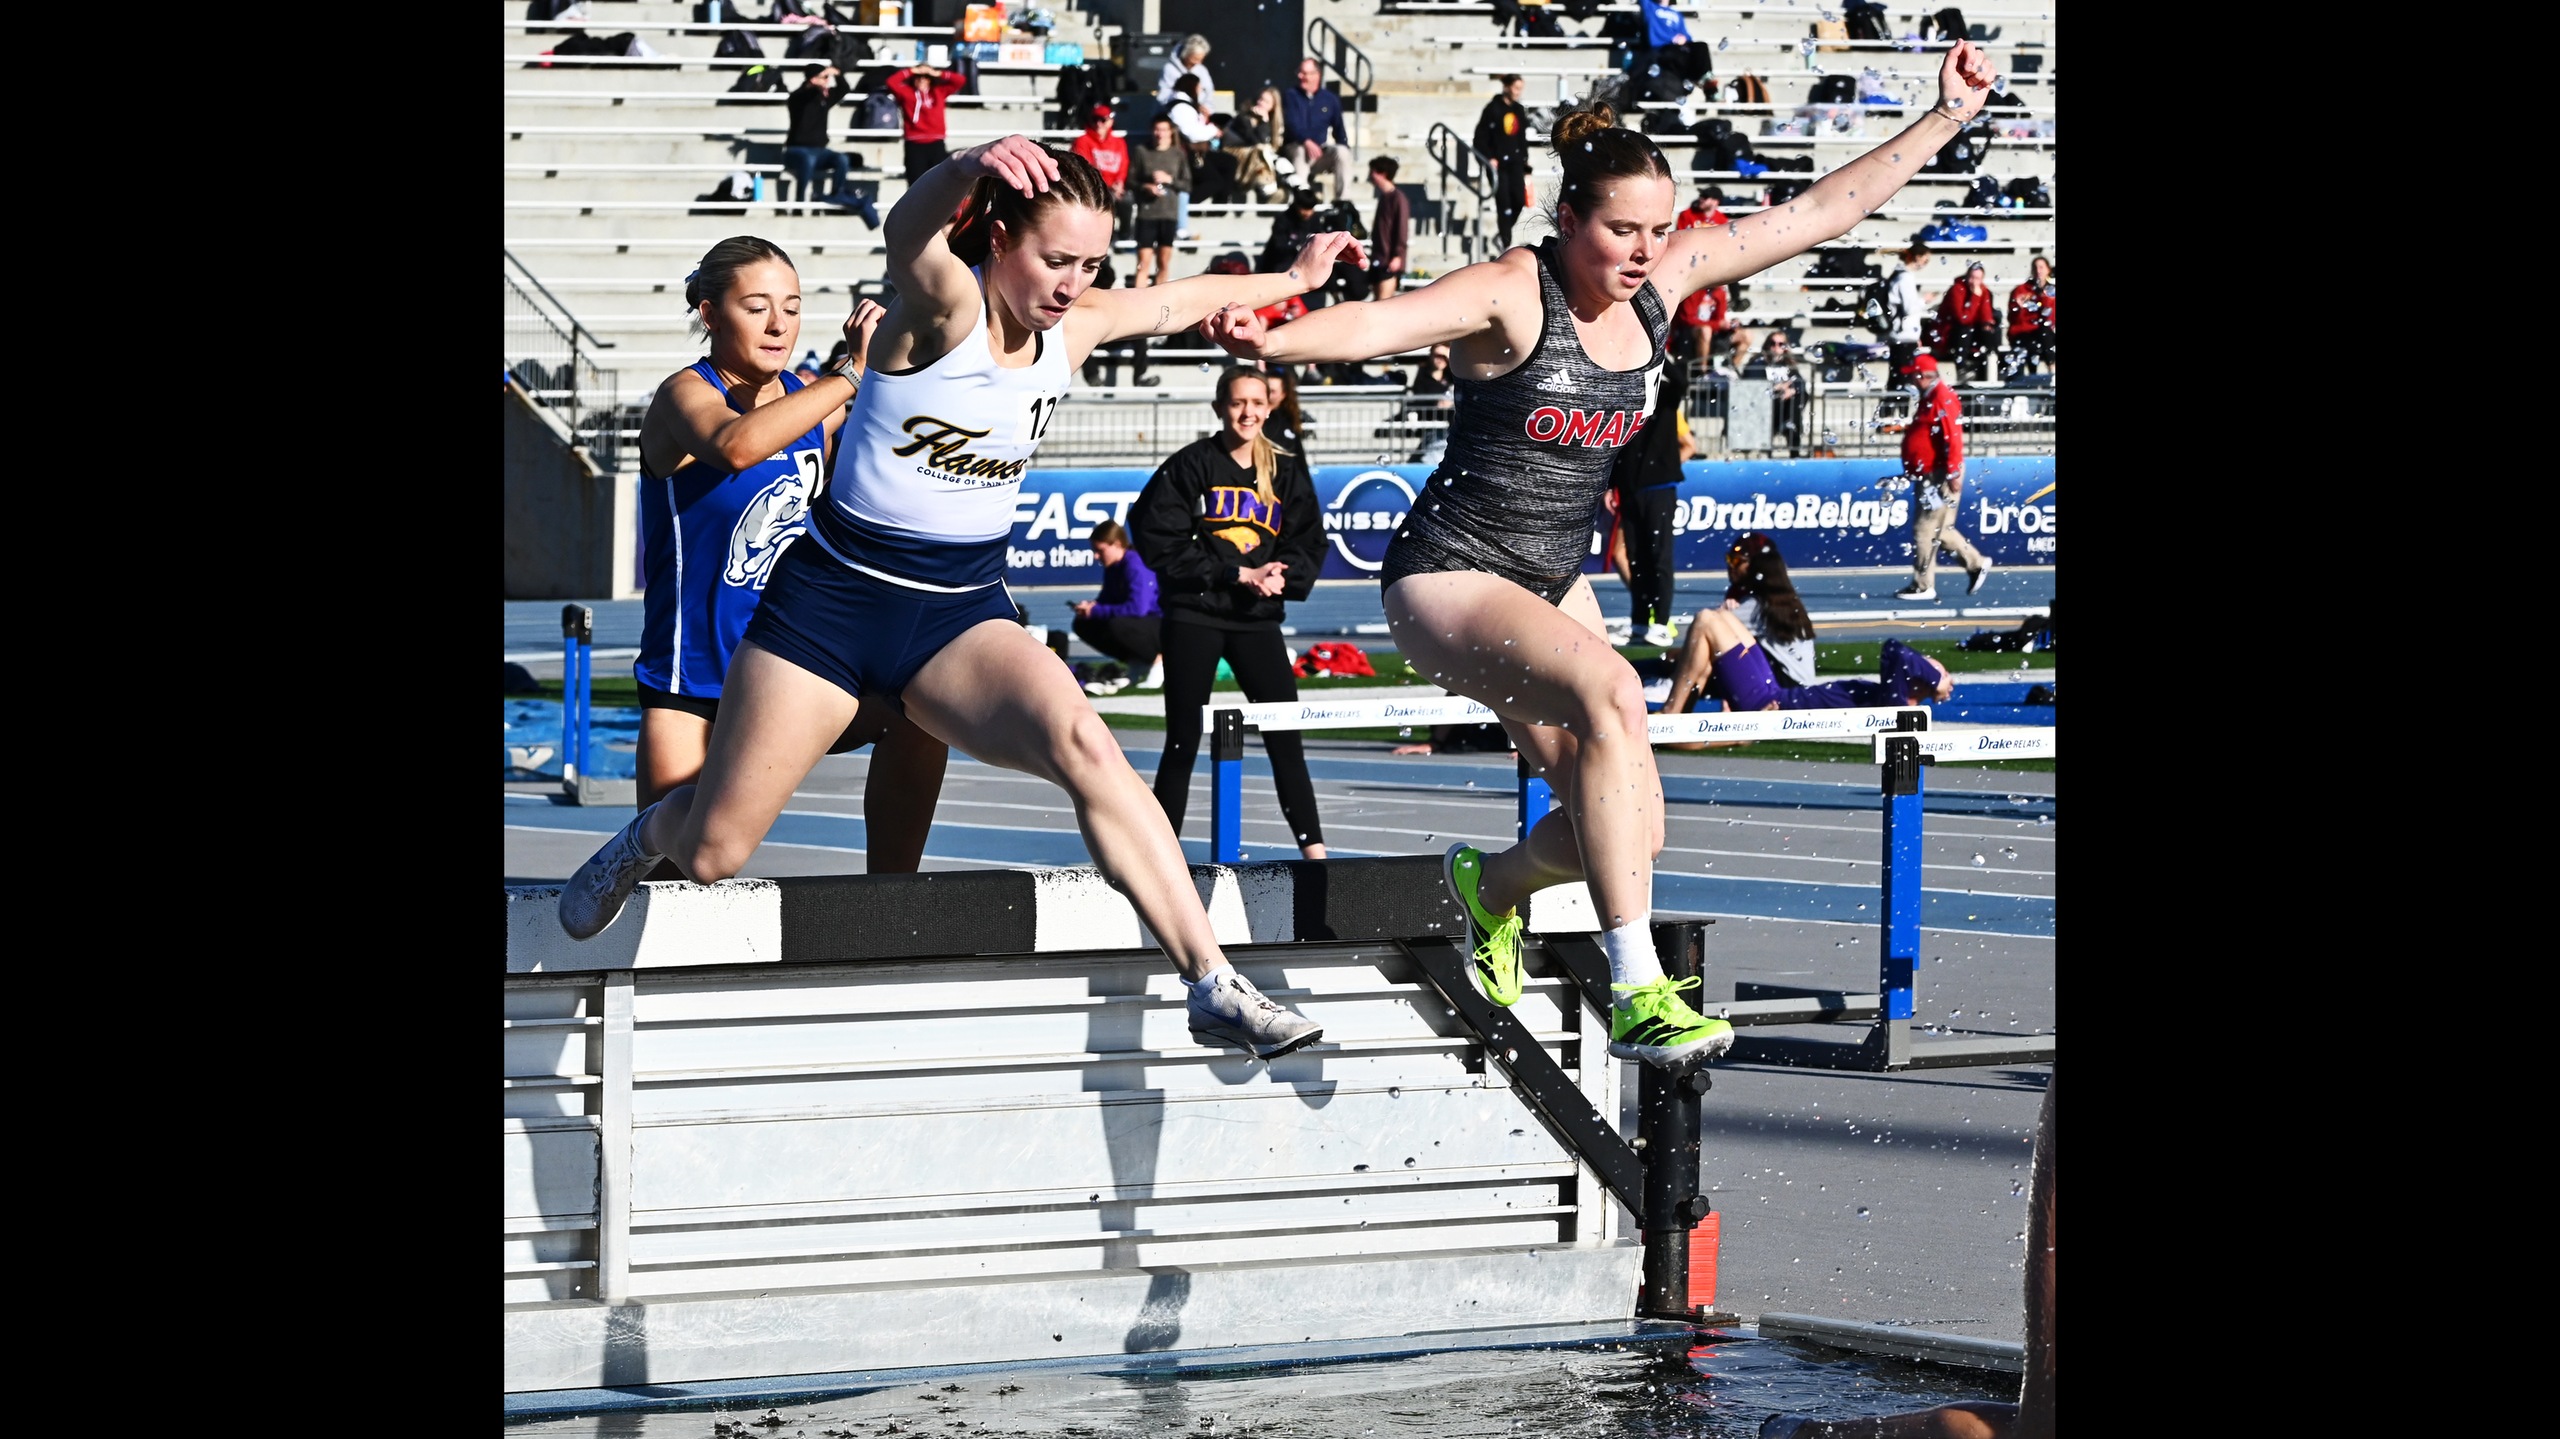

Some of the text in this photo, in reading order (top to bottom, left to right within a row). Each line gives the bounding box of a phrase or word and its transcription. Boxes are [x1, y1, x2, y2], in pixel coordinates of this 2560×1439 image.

[1537, 382, 1577, 394] adidas
[916, 466, 961, 484] COLLEGE
[964, 478, 976, 486] OF
[1049, 543, 1094, 568] than
[1301, 707, 1333, 719] Drake
[1384, 705, 1416, 717] Drake
[1698, 719, 1759, 732] Drake RELAYS
[1782, 716, 1842, 730] Drake RELAYS
[1925, 742, 1953, 752] RELAYS
[1978, 736, 2041, 750] Drake RELAYS
